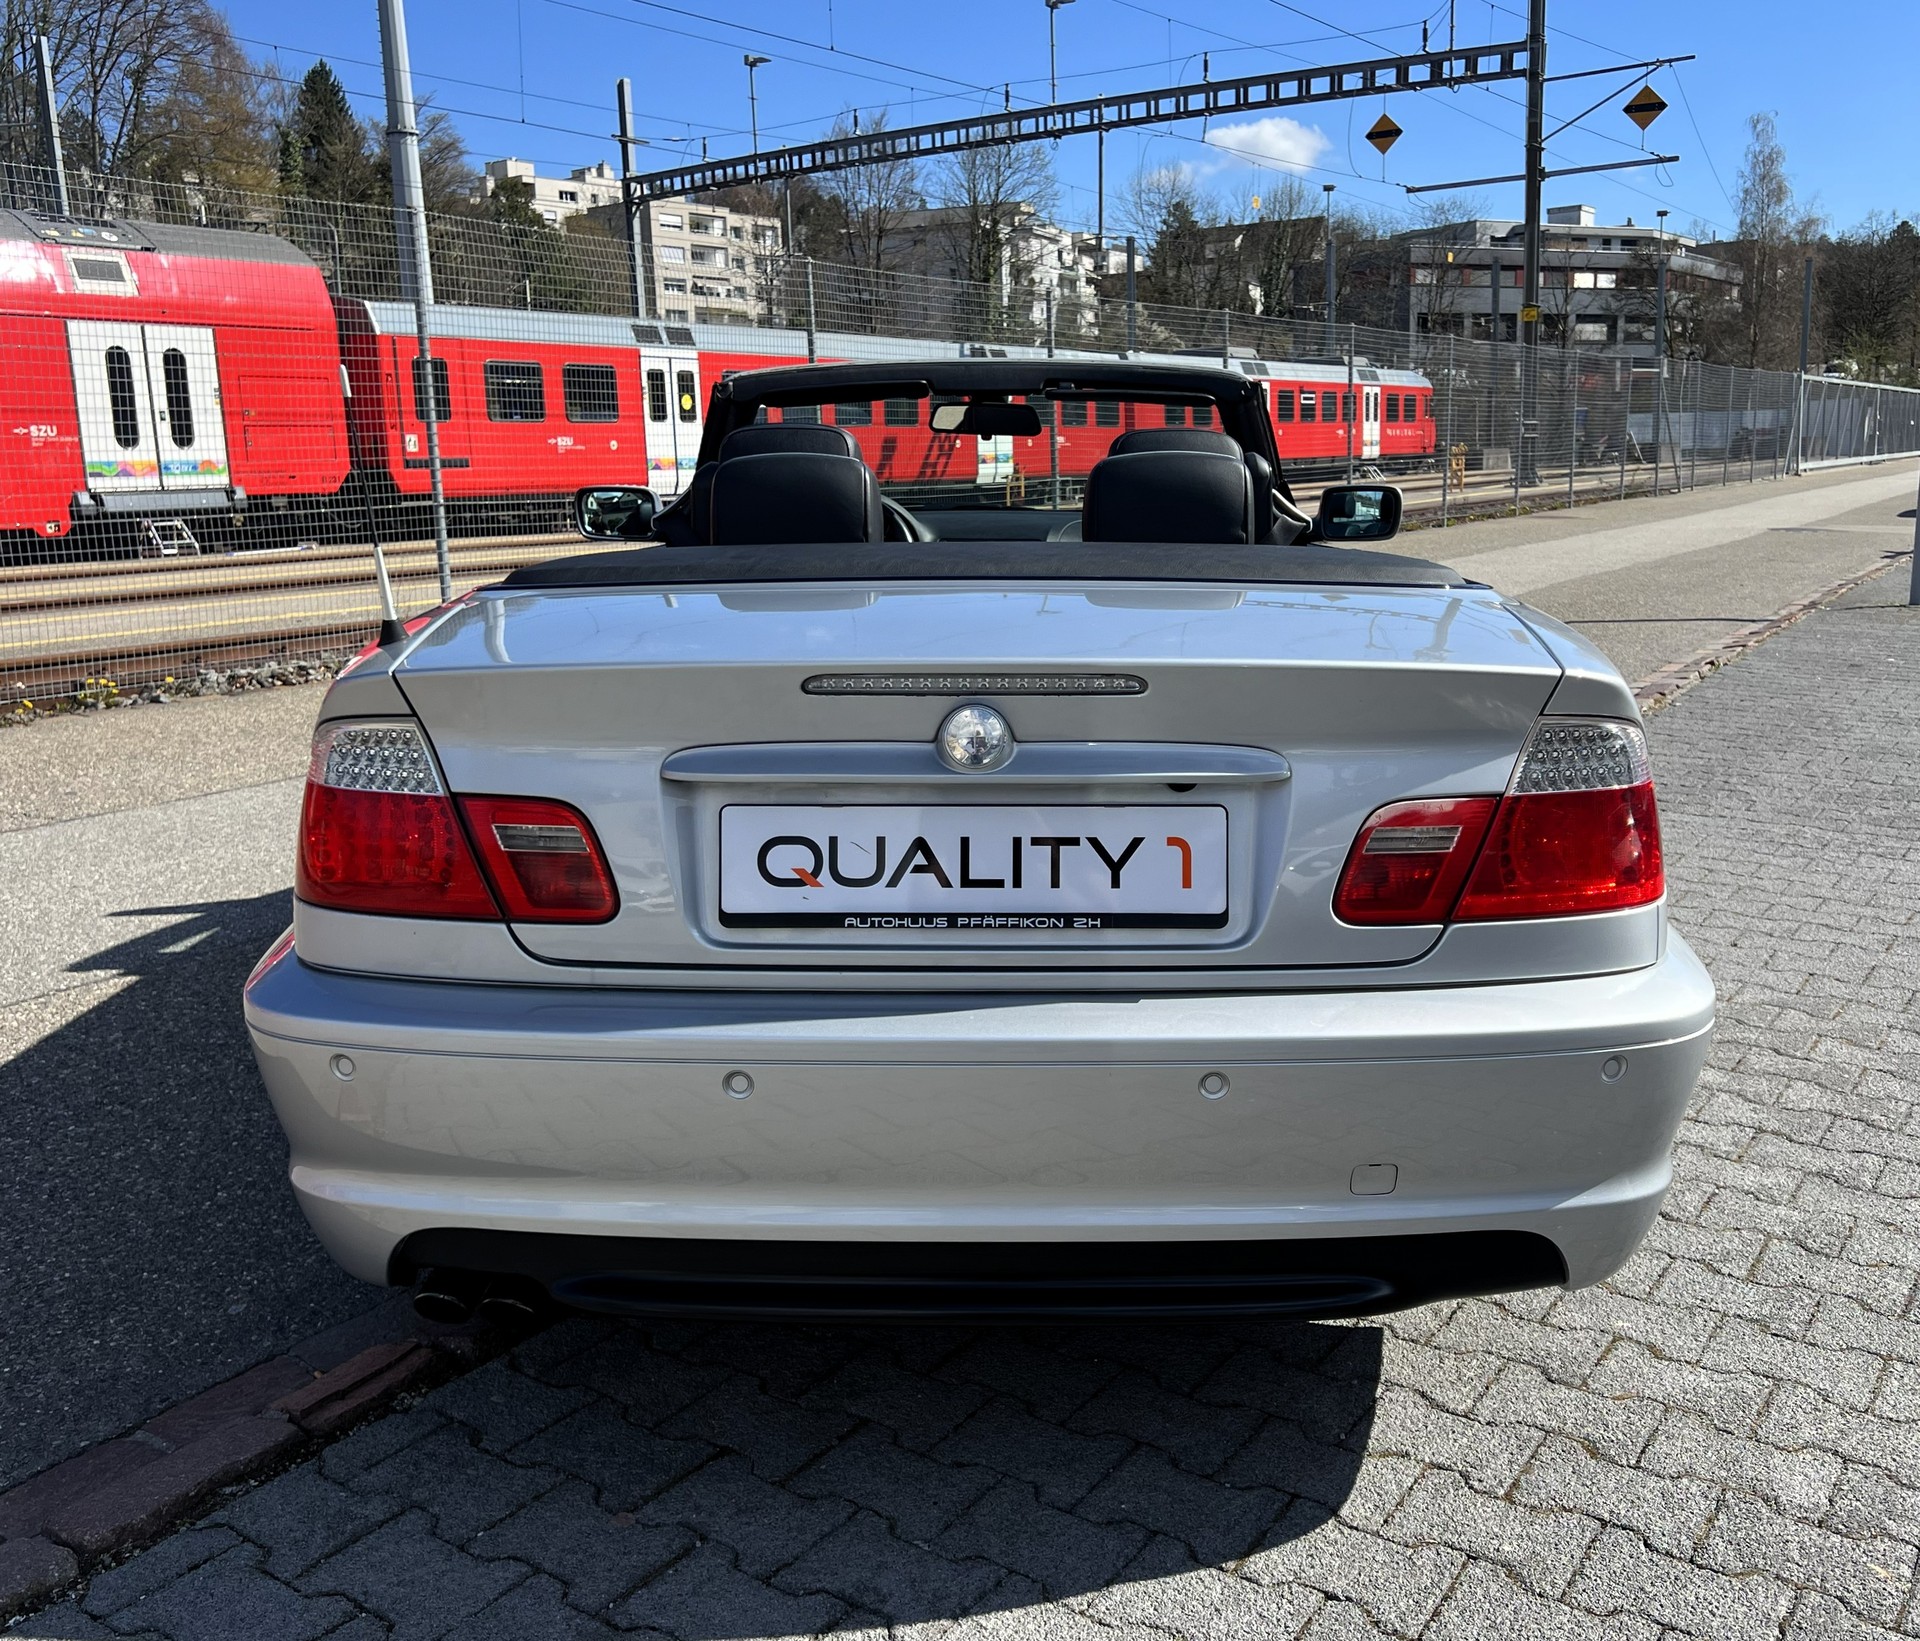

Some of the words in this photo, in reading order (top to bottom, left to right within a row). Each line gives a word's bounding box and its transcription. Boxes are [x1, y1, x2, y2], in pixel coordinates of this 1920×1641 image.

[29, 424, 58, 437] SZU
[756, 835, 1146, 889] QUALITY
[1166, 836, 1193, 889] 1
[844, 917, 948, 928] AUTOHUUS
[957, 914, 1064, 928] PFÄFFIKON
